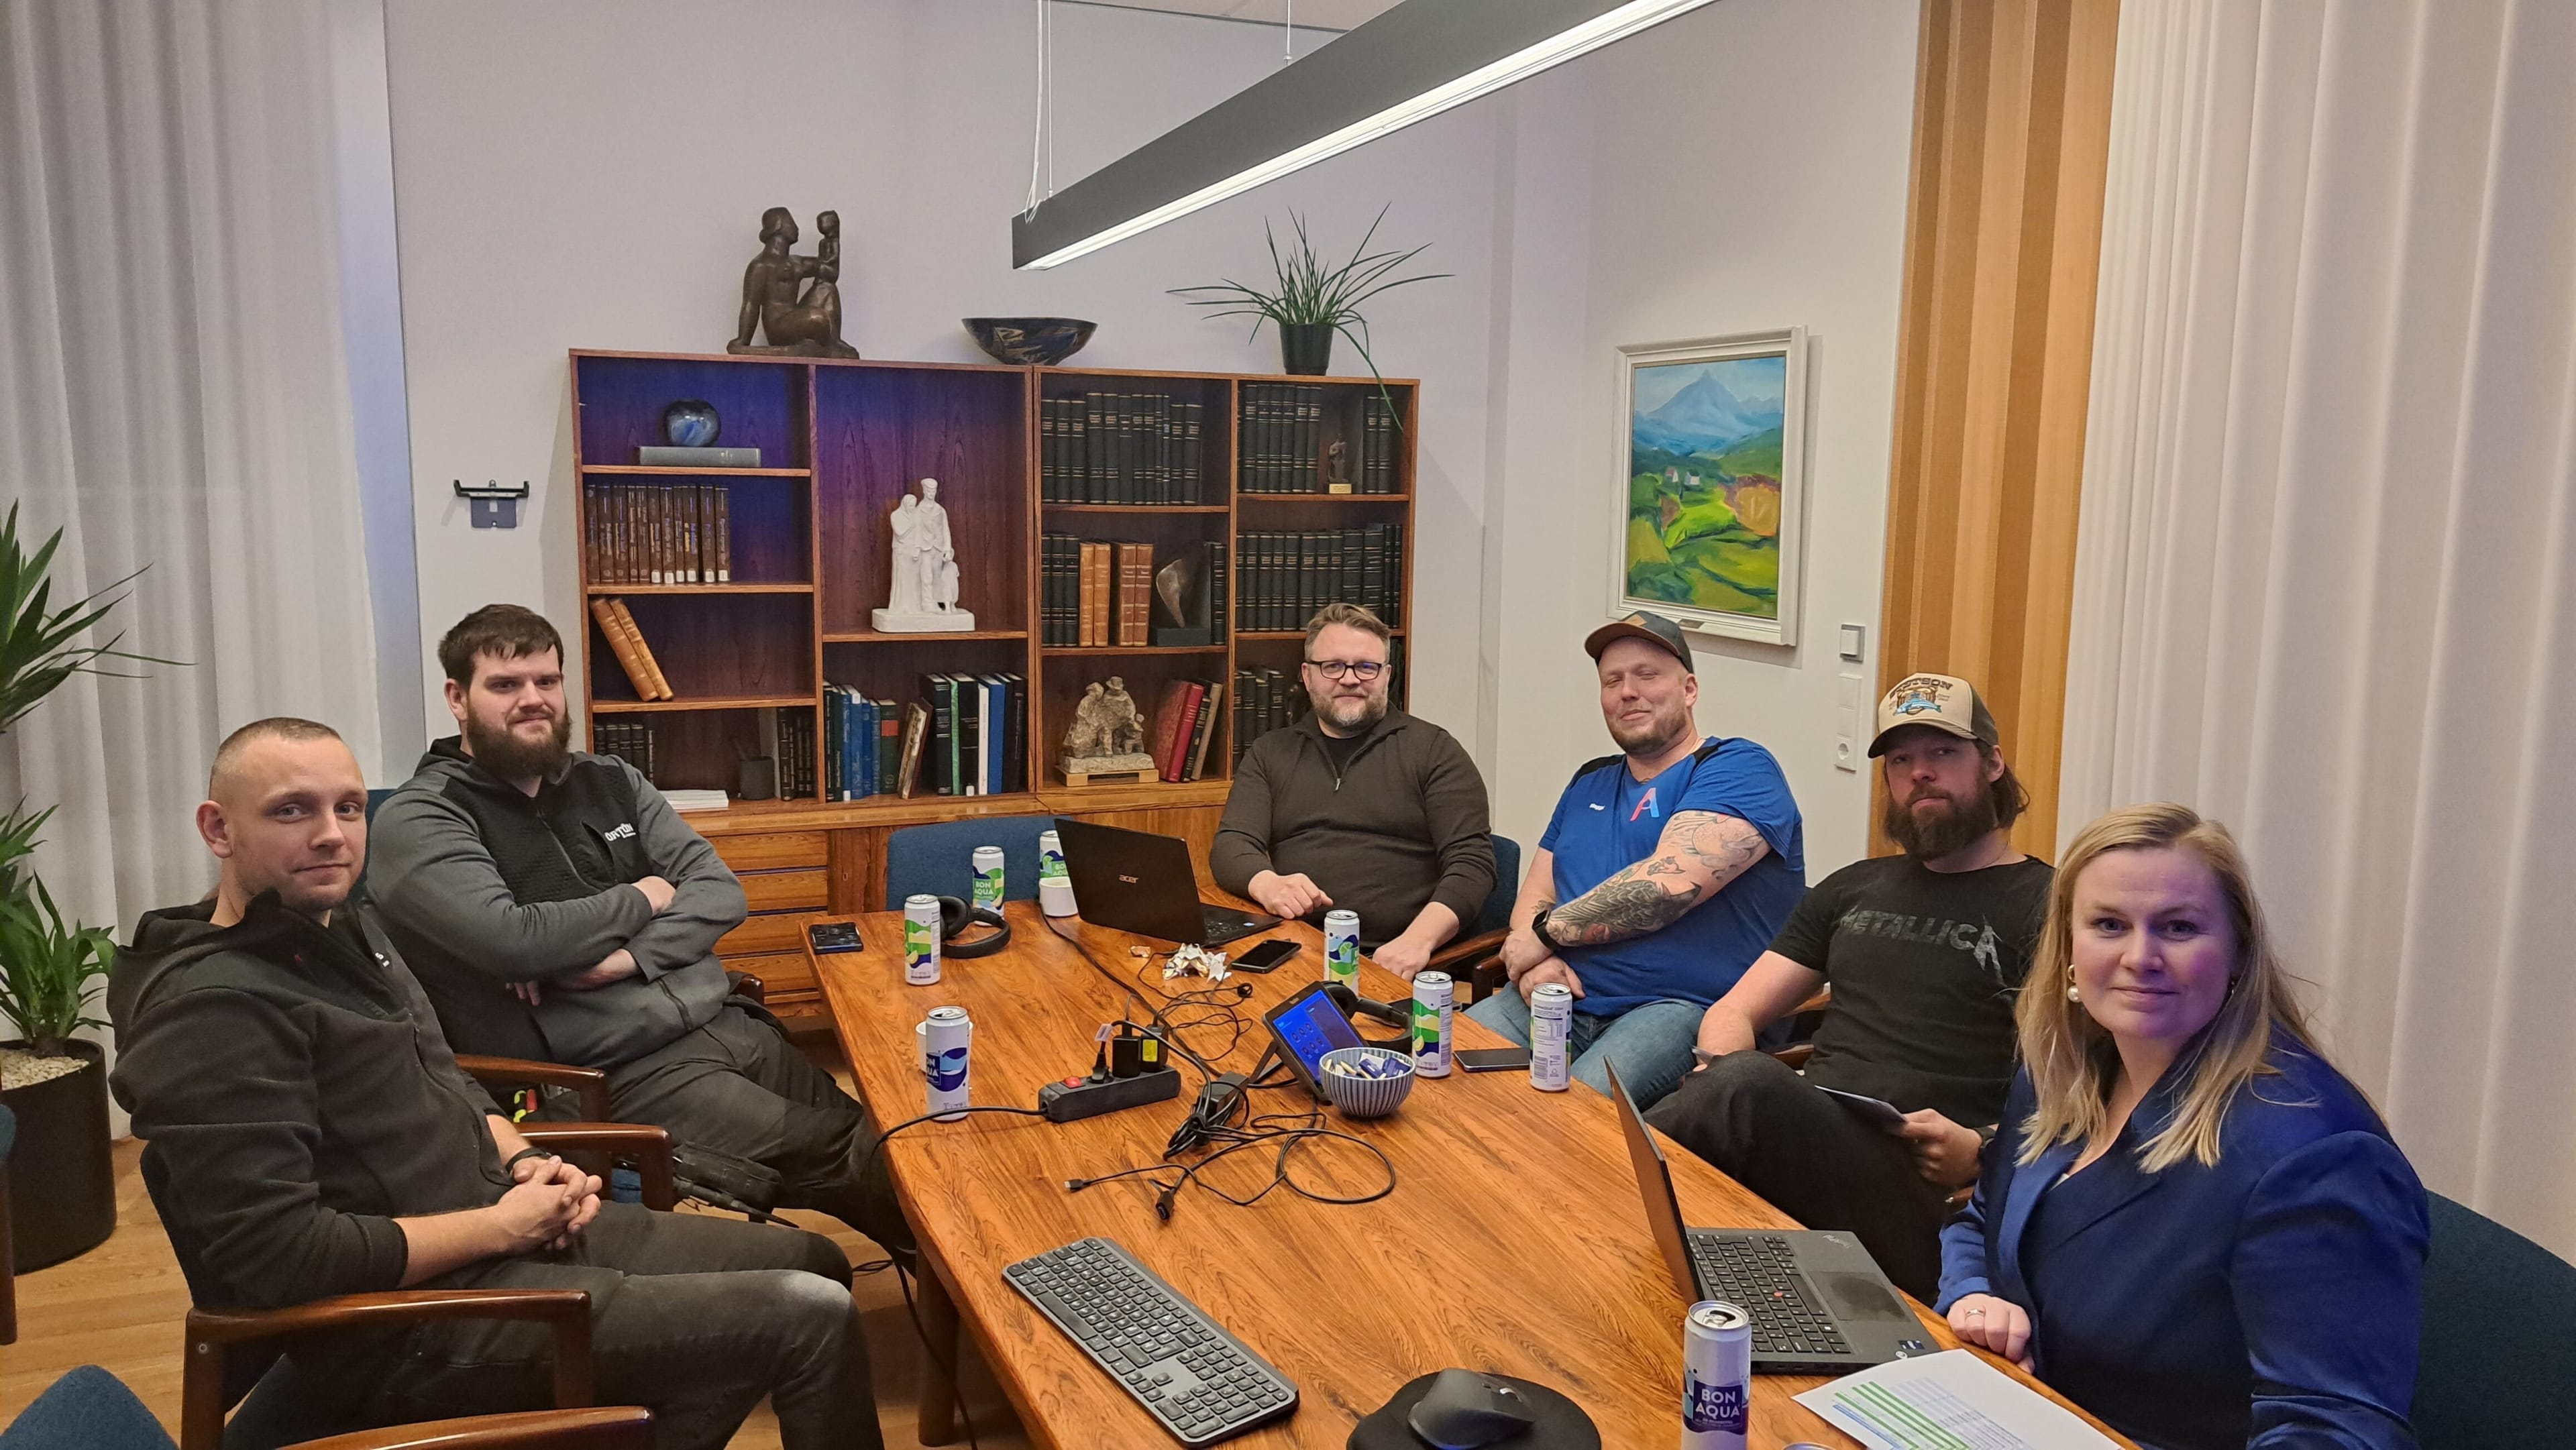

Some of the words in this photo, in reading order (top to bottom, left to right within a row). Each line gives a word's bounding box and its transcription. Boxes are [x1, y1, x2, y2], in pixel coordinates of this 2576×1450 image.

[1118, 874, 1139, 883] acer
[1701, 1388, 1736, 1404] BON
[1695, 1402, 1740, 1420] AQUA
